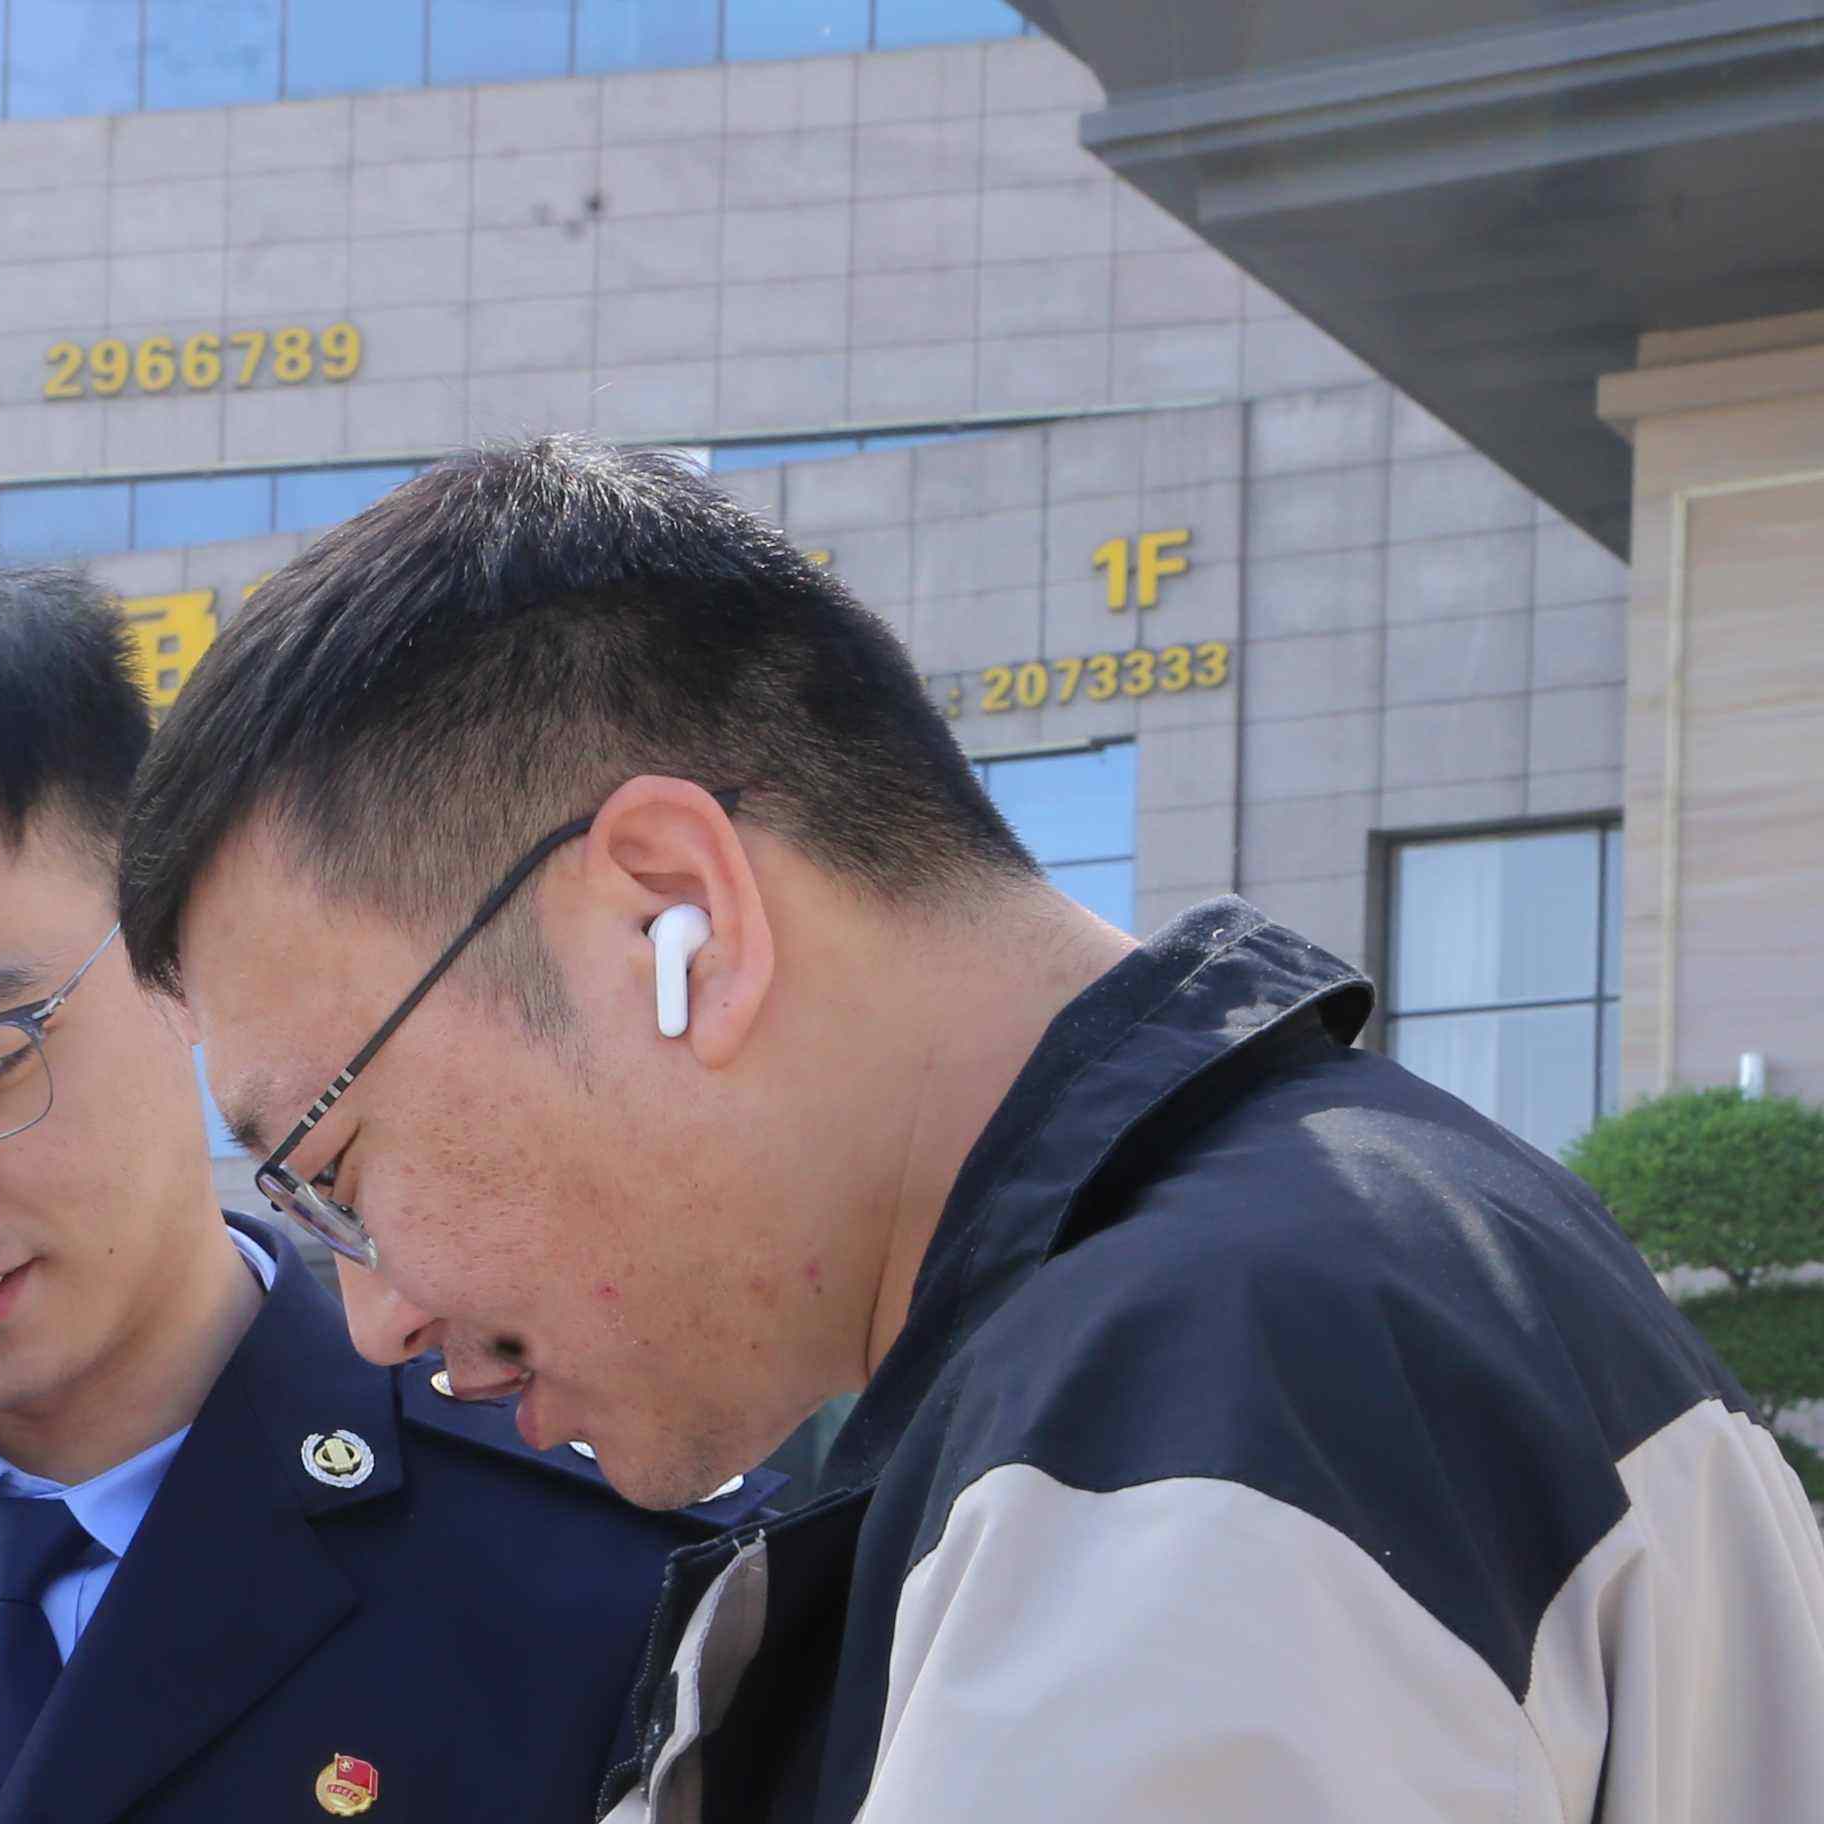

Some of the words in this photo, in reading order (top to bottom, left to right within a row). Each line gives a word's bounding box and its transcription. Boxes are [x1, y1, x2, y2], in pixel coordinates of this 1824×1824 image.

[44, 322, 360, 402] 2966789
[1092, 529, 1191, 611] 1F
[981, 642, 1229, 713] 2073333
